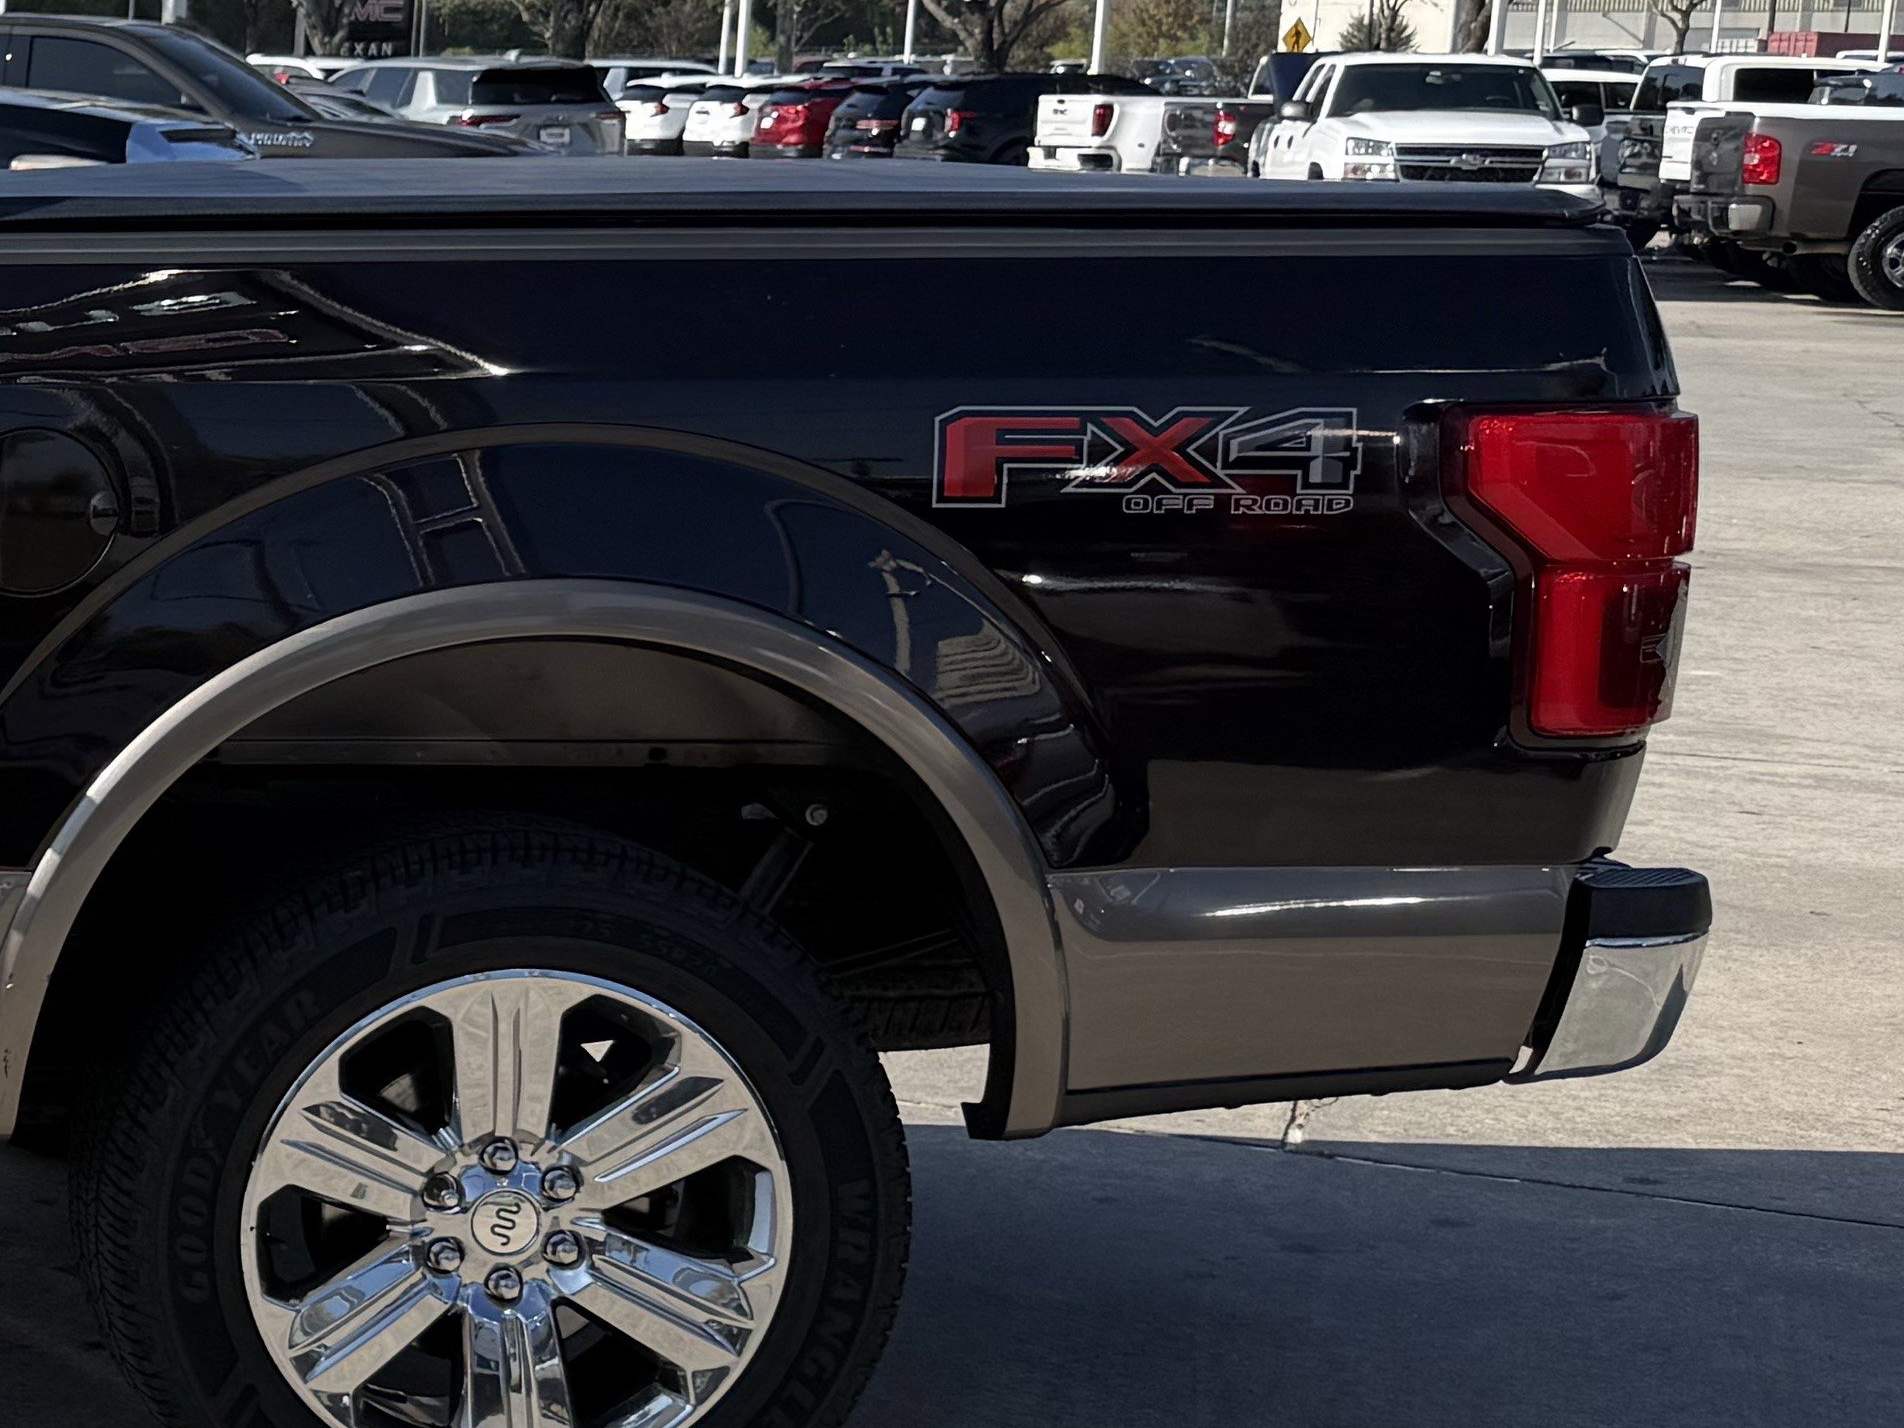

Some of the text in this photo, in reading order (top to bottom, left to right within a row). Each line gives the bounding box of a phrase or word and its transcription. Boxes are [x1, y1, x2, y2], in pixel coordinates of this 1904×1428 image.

[932, 406, 1362, 508] FX4
[1123, 495, 1355, 514] OFF ROAD
